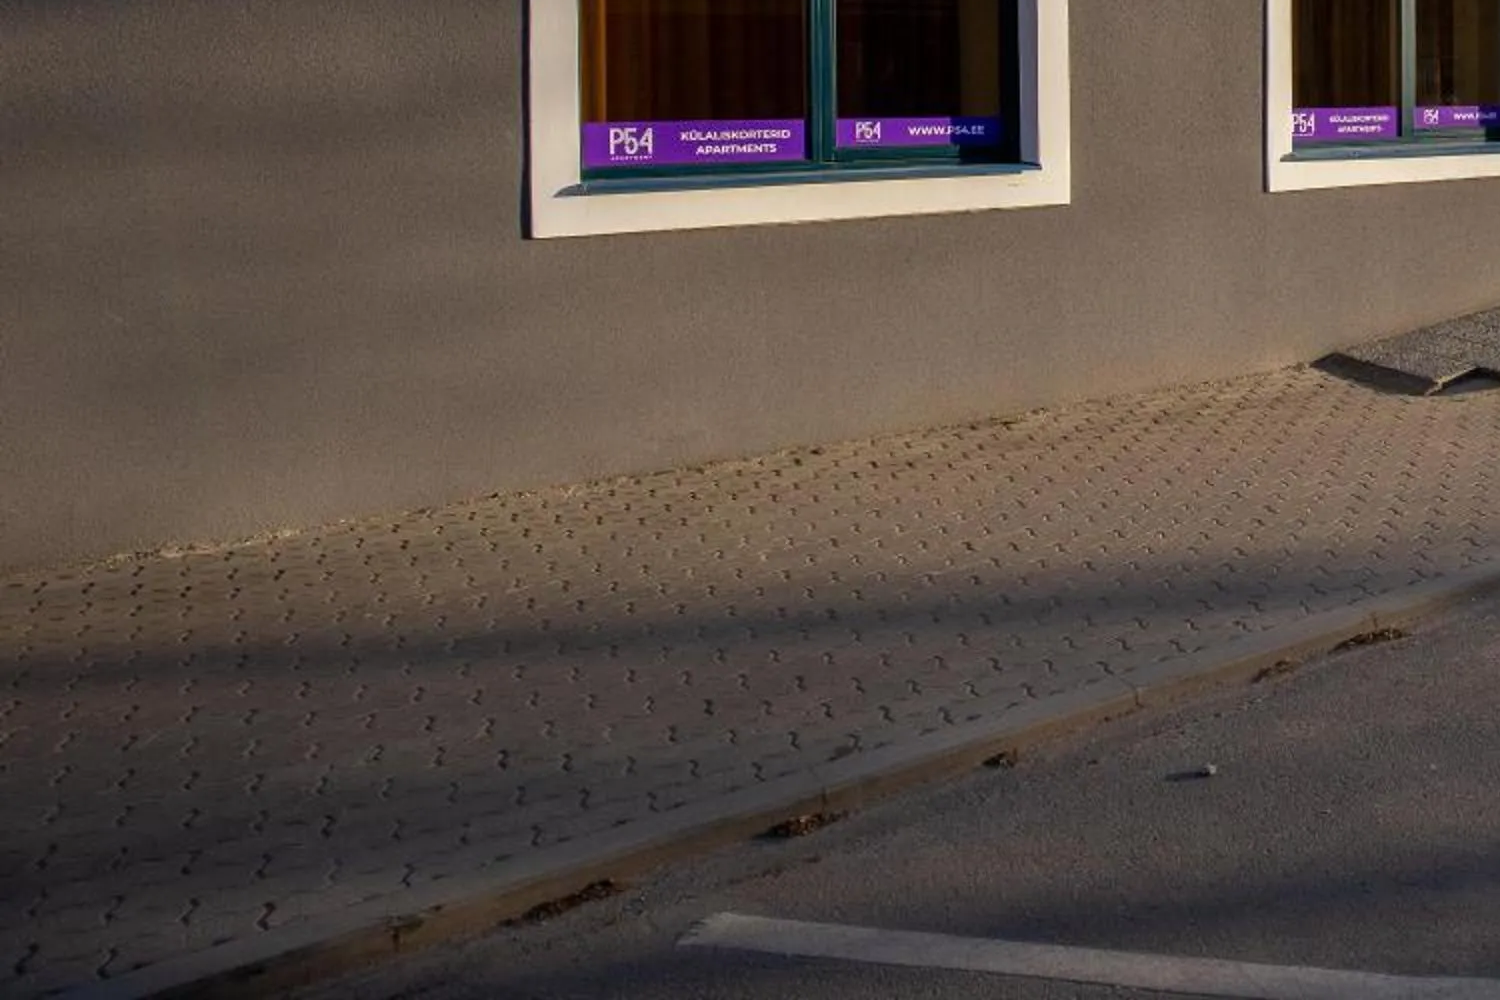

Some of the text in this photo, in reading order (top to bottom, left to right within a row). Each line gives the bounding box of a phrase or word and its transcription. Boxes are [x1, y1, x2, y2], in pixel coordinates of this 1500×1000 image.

[855, 121, 881, 140] P54
[609, 127, 653, 155] P54
[695, 143, 777, 155] APARTMENTS
